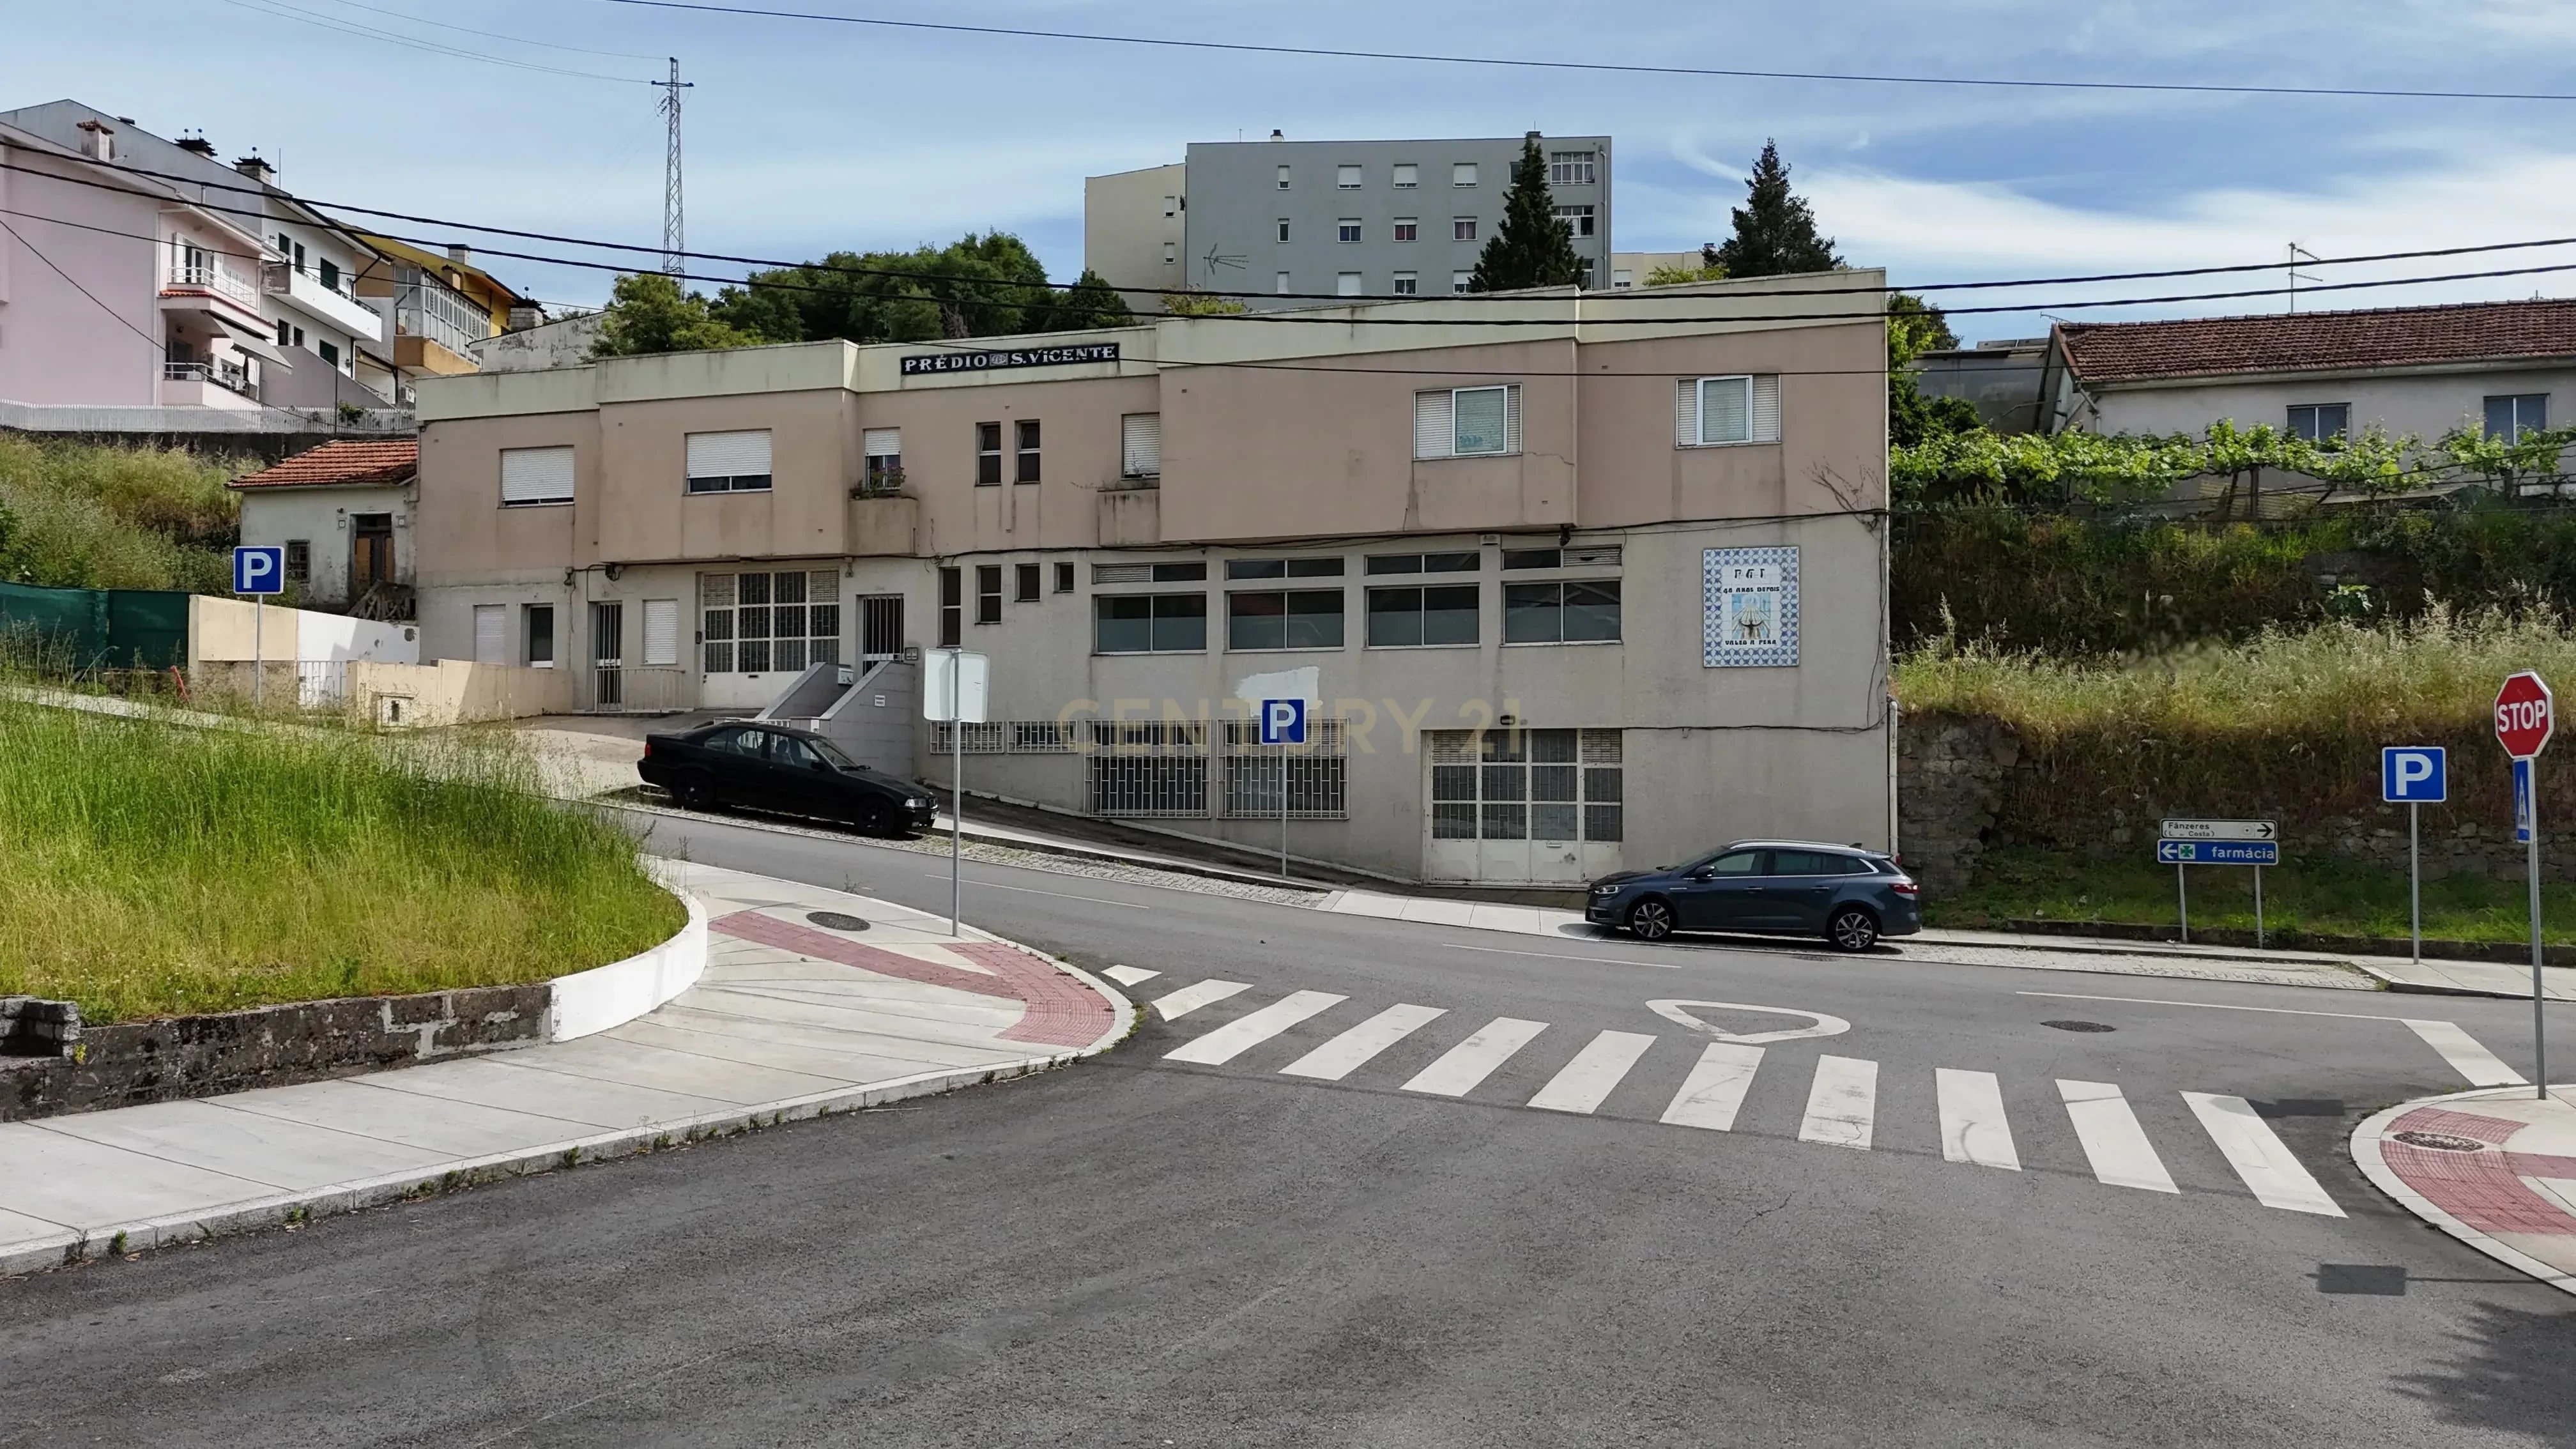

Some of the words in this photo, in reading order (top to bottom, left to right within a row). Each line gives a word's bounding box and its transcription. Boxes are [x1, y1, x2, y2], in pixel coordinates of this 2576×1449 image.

[905, 355, 987, 371] PRÉDIO
[243, 551, 272, 589] P
[1269, 703, 1296, 739] P
[2497, 700, 2547, 733] STOP
[2395, 753, 2434, 796] P
[2212, 846, 2274, 859] farmácia
